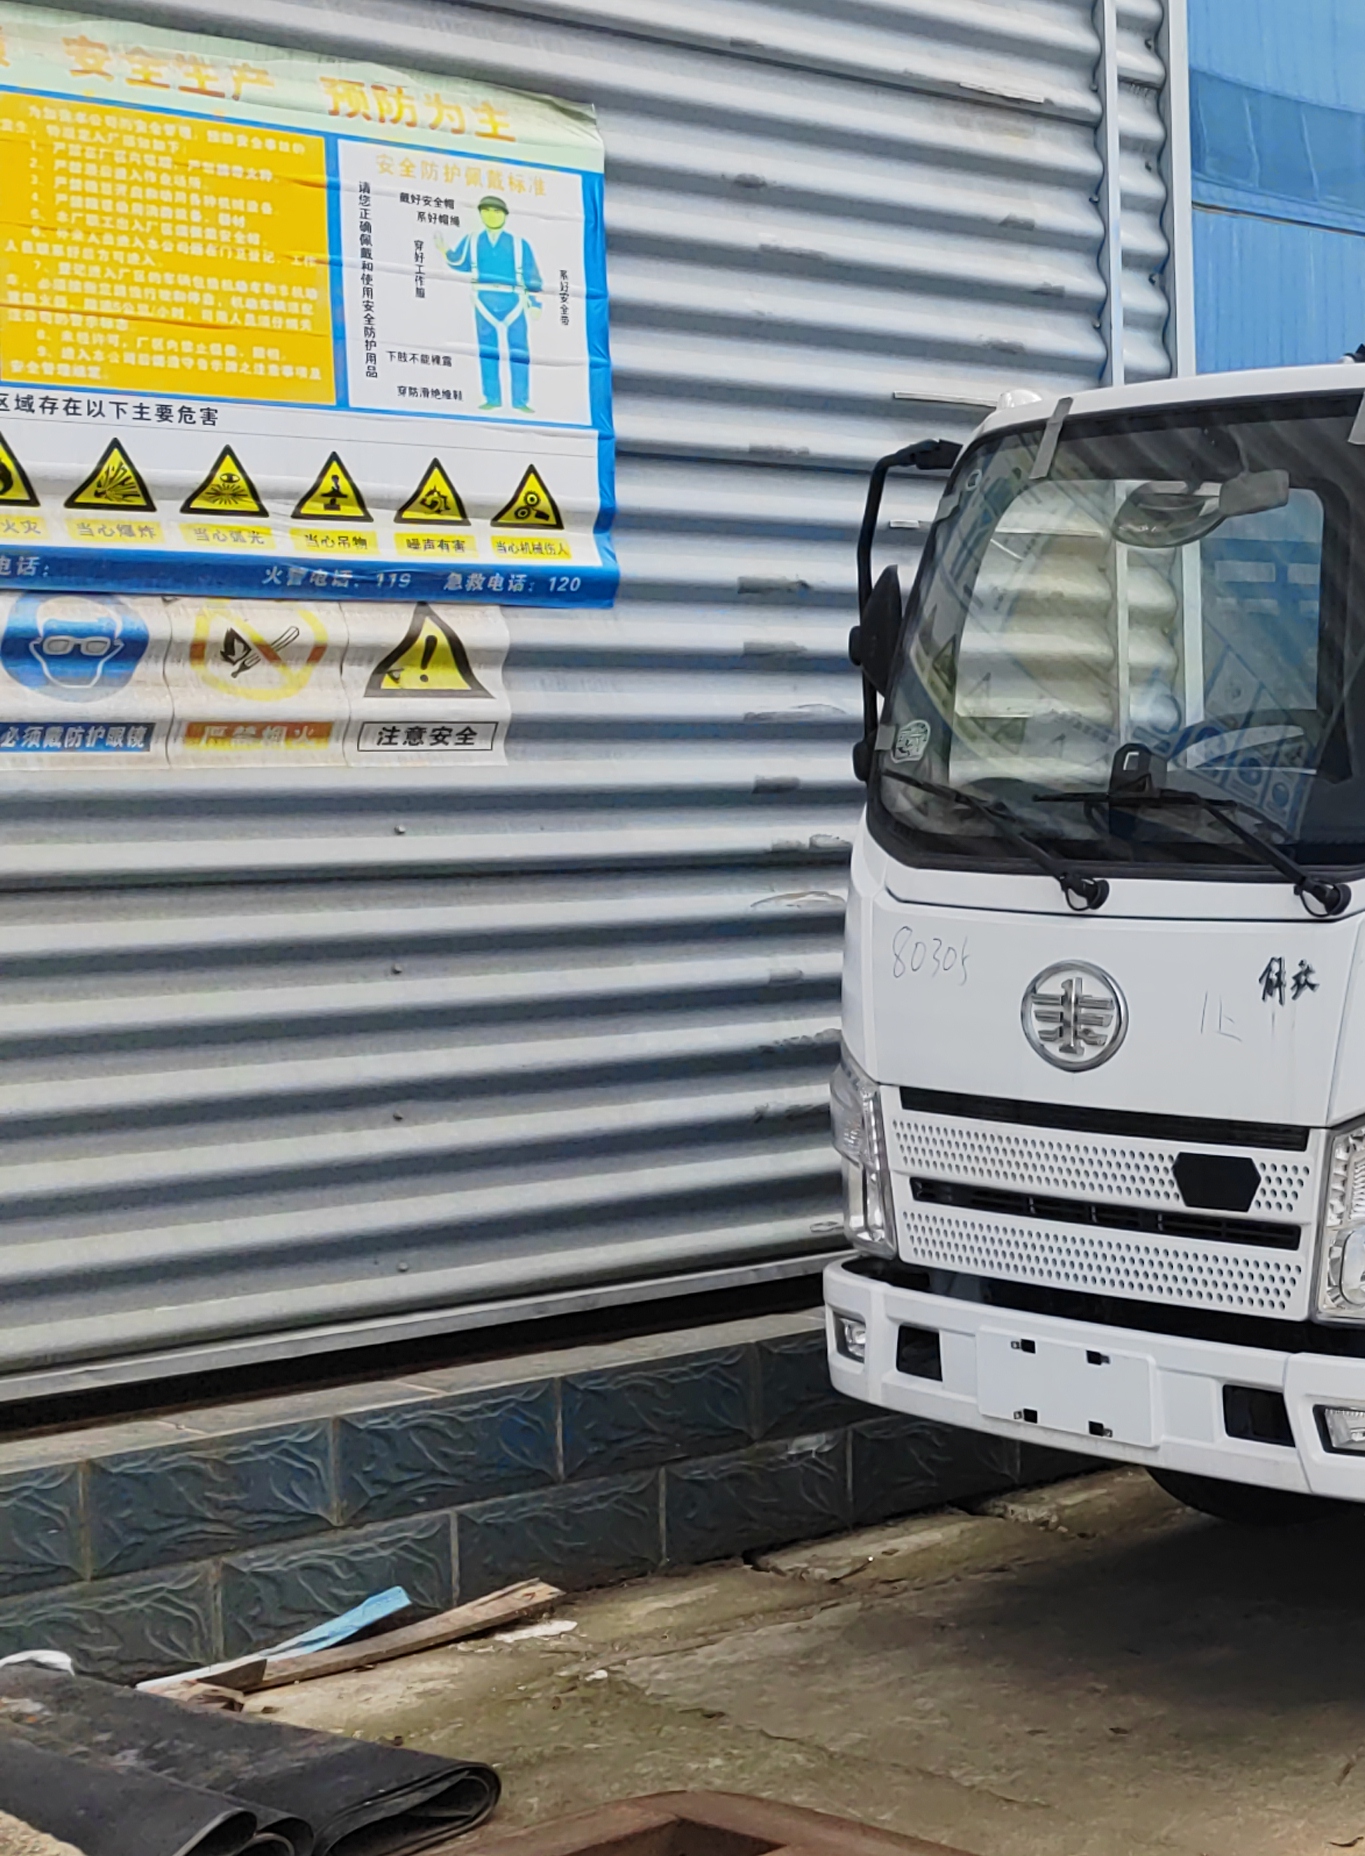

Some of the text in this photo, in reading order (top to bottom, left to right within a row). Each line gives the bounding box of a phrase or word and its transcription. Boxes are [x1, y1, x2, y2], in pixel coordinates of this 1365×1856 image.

[61, 34, 275, 101] 安全生产
[319, 76, 517, 142] 预防为主
[376, 153, 547, 197] 安全防护佩戴标准
[400, 192, 455, 210] 戴好安全帽
[416, 211, 461, 227] 系好帽绳
[413, 239, 426, 298] 穿好工作服
[358, 181, 378, 379] 请您正确佩戴和使用安全防护用品
[559, 269, 570, 326] 系好安全带
[386, 350, 453, 368] 下肢不能裸露
[76, 520, 157, 540] 当心爆炸
[193, 526, 266, 545] 当心弧光
[304, 533, 368, 550] 当心吊物
[406, 538, 466, 553] 噪声有害
[496, 540, 570, 557] 当心机械伤人
[0, 725, 148, 749] 必须戴防护眼镜
[376, 724, 480, 748] 注意安全
